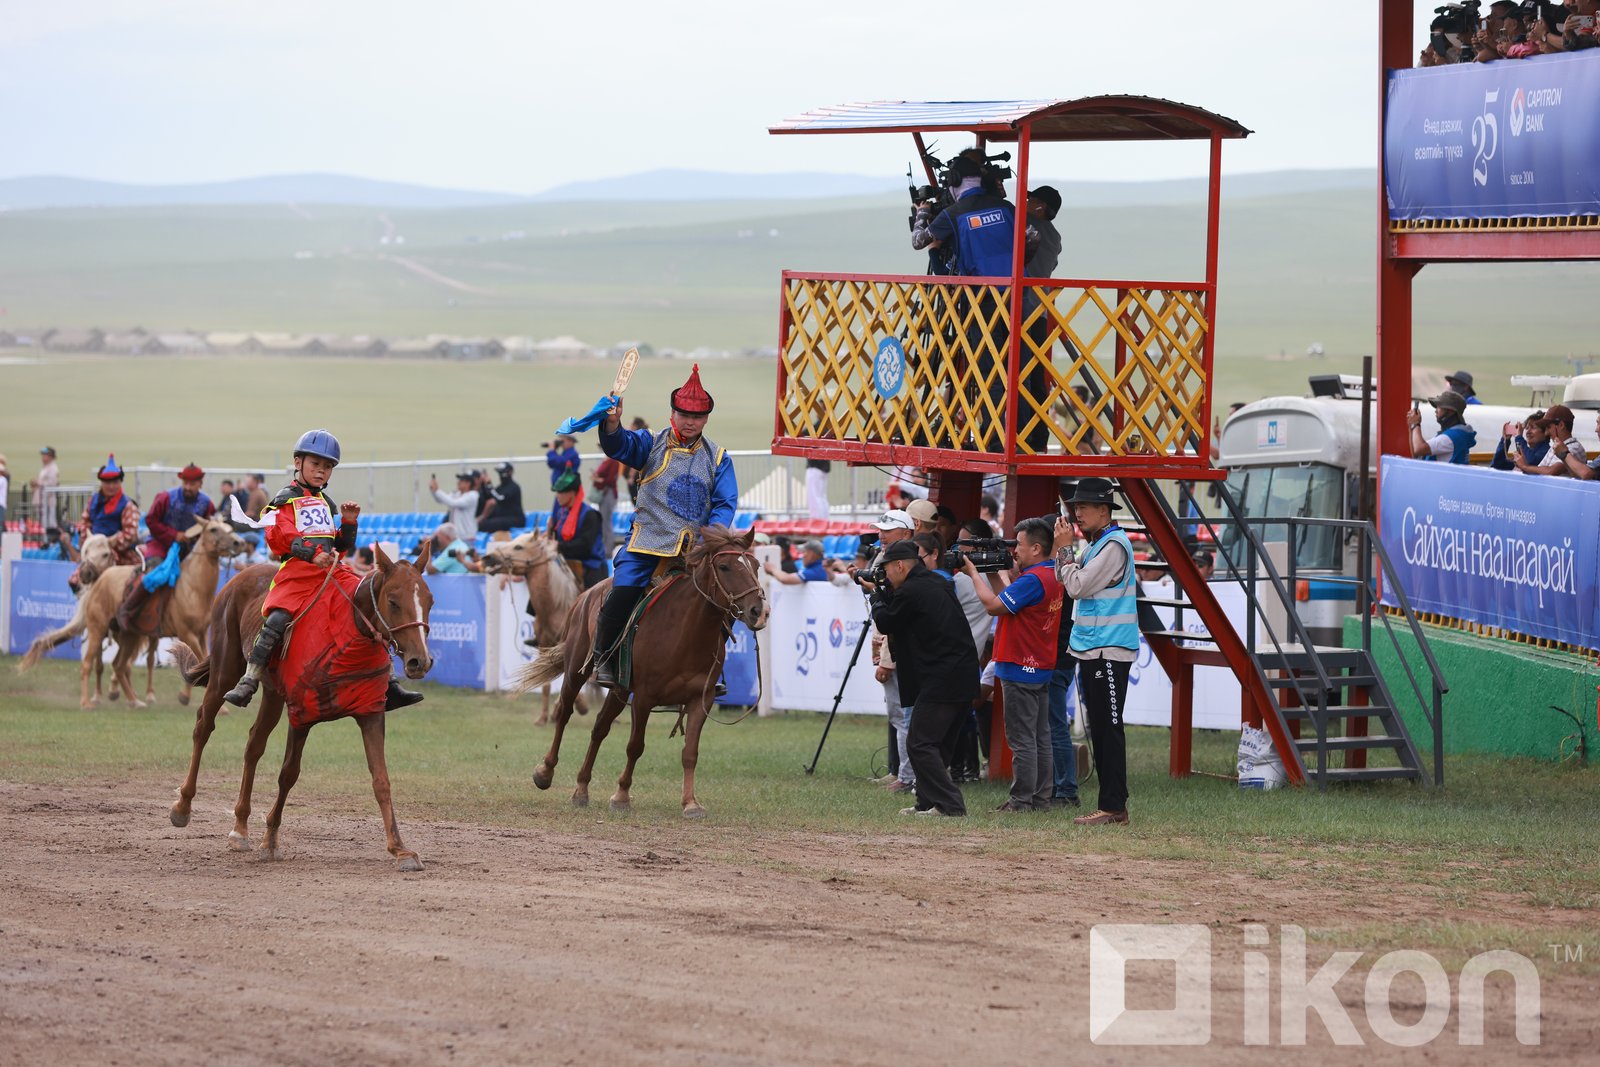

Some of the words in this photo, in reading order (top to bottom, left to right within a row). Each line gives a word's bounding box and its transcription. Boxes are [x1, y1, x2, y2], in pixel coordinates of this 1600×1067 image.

[1527, 88, 1562, 108] CAPITRON
[1526, 114, 1544, 132] BANK
[1471, 87, 1500, 187] 25
[982, 213, 1001, 224] ntv
[301, 507, 331, 527] 338
[1486, 502, 1504, 520] Өргөн
[1402, 506, 1468, 573] Сайхан
[1472, 532, 1577, 609] наадаарай
[796, 617, 819, 677] 25
